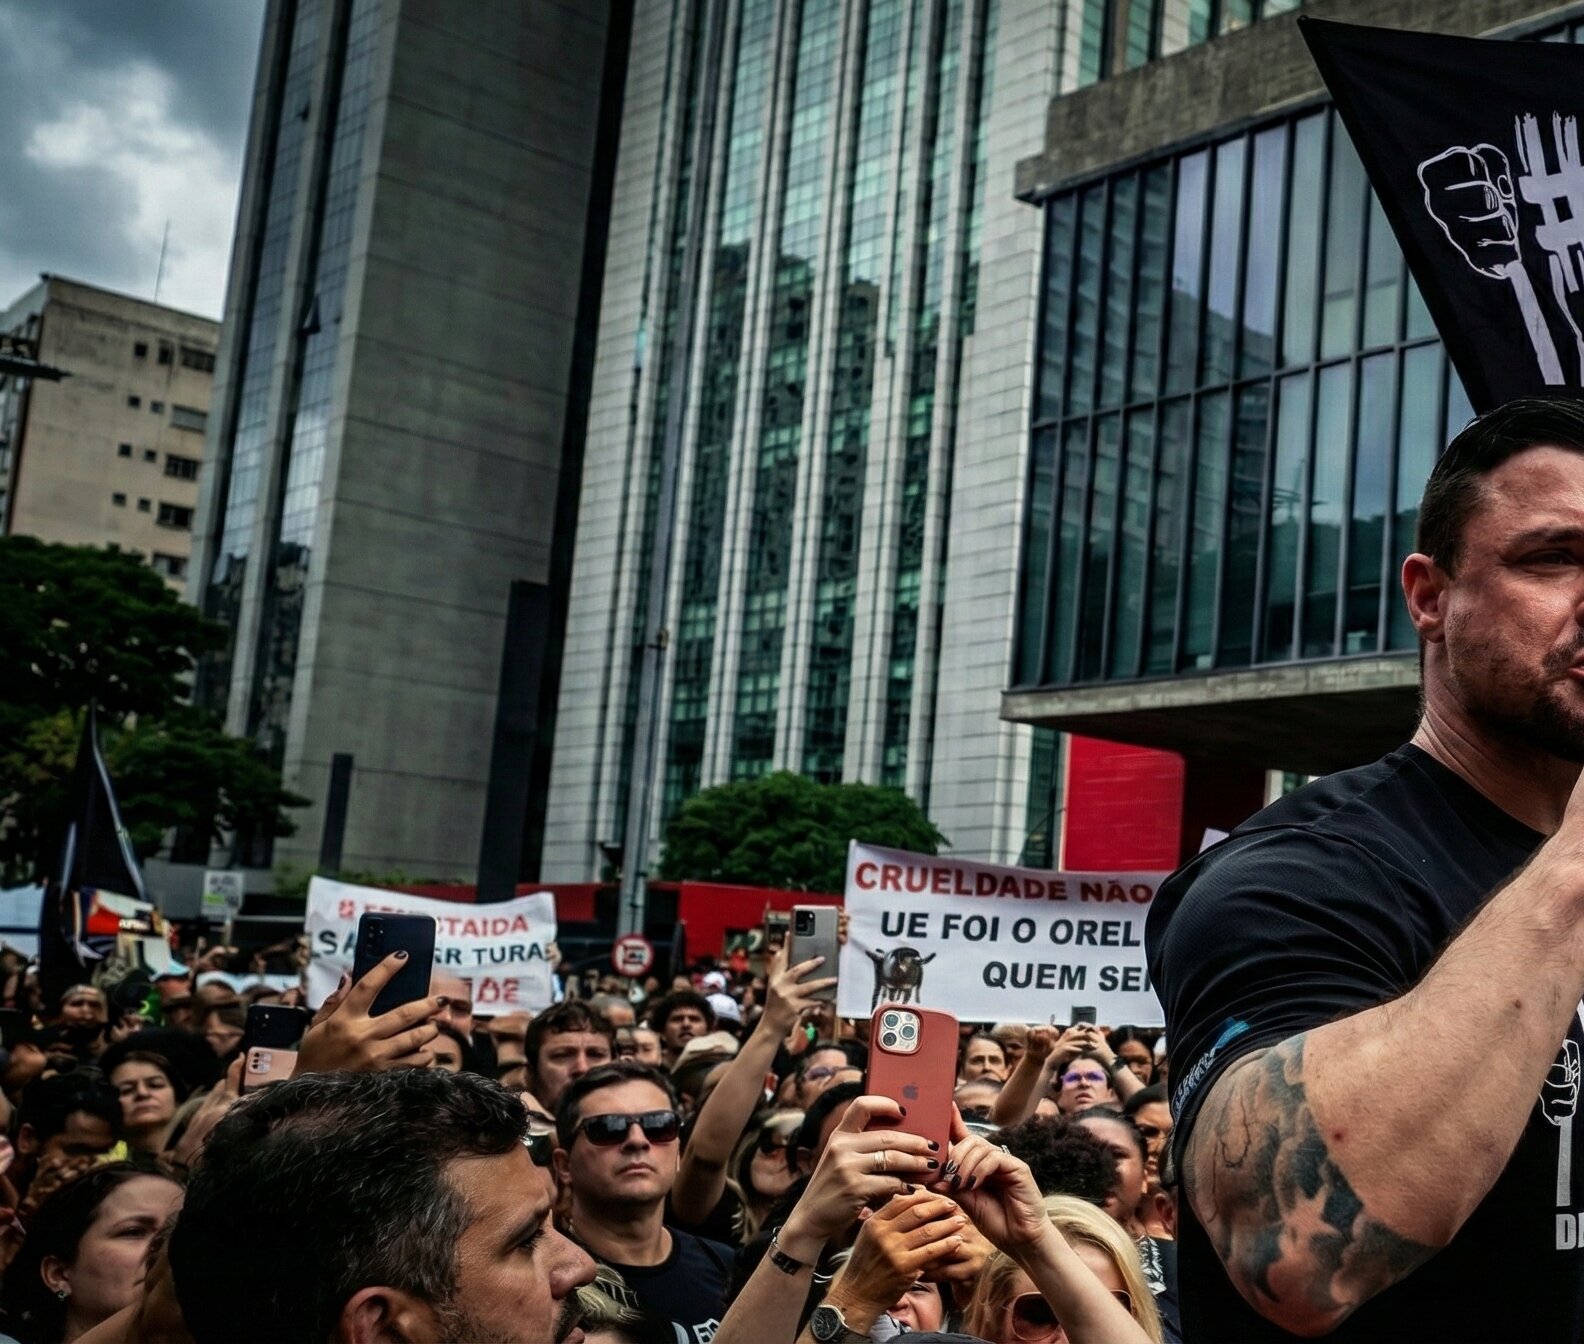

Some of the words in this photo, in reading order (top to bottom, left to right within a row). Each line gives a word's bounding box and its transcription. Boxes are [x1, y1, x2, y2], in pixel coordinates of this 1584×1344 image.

[855, 861, 1067, 901] CRUELDADE
[1080, 880, 1154, 905] NÃO
[881, 910, 929, 938] UE
[941, 913, 1000, 942] FOI
[1011, 917, 1037, 944] O
[982, 960, 1087, 991] QUEM
